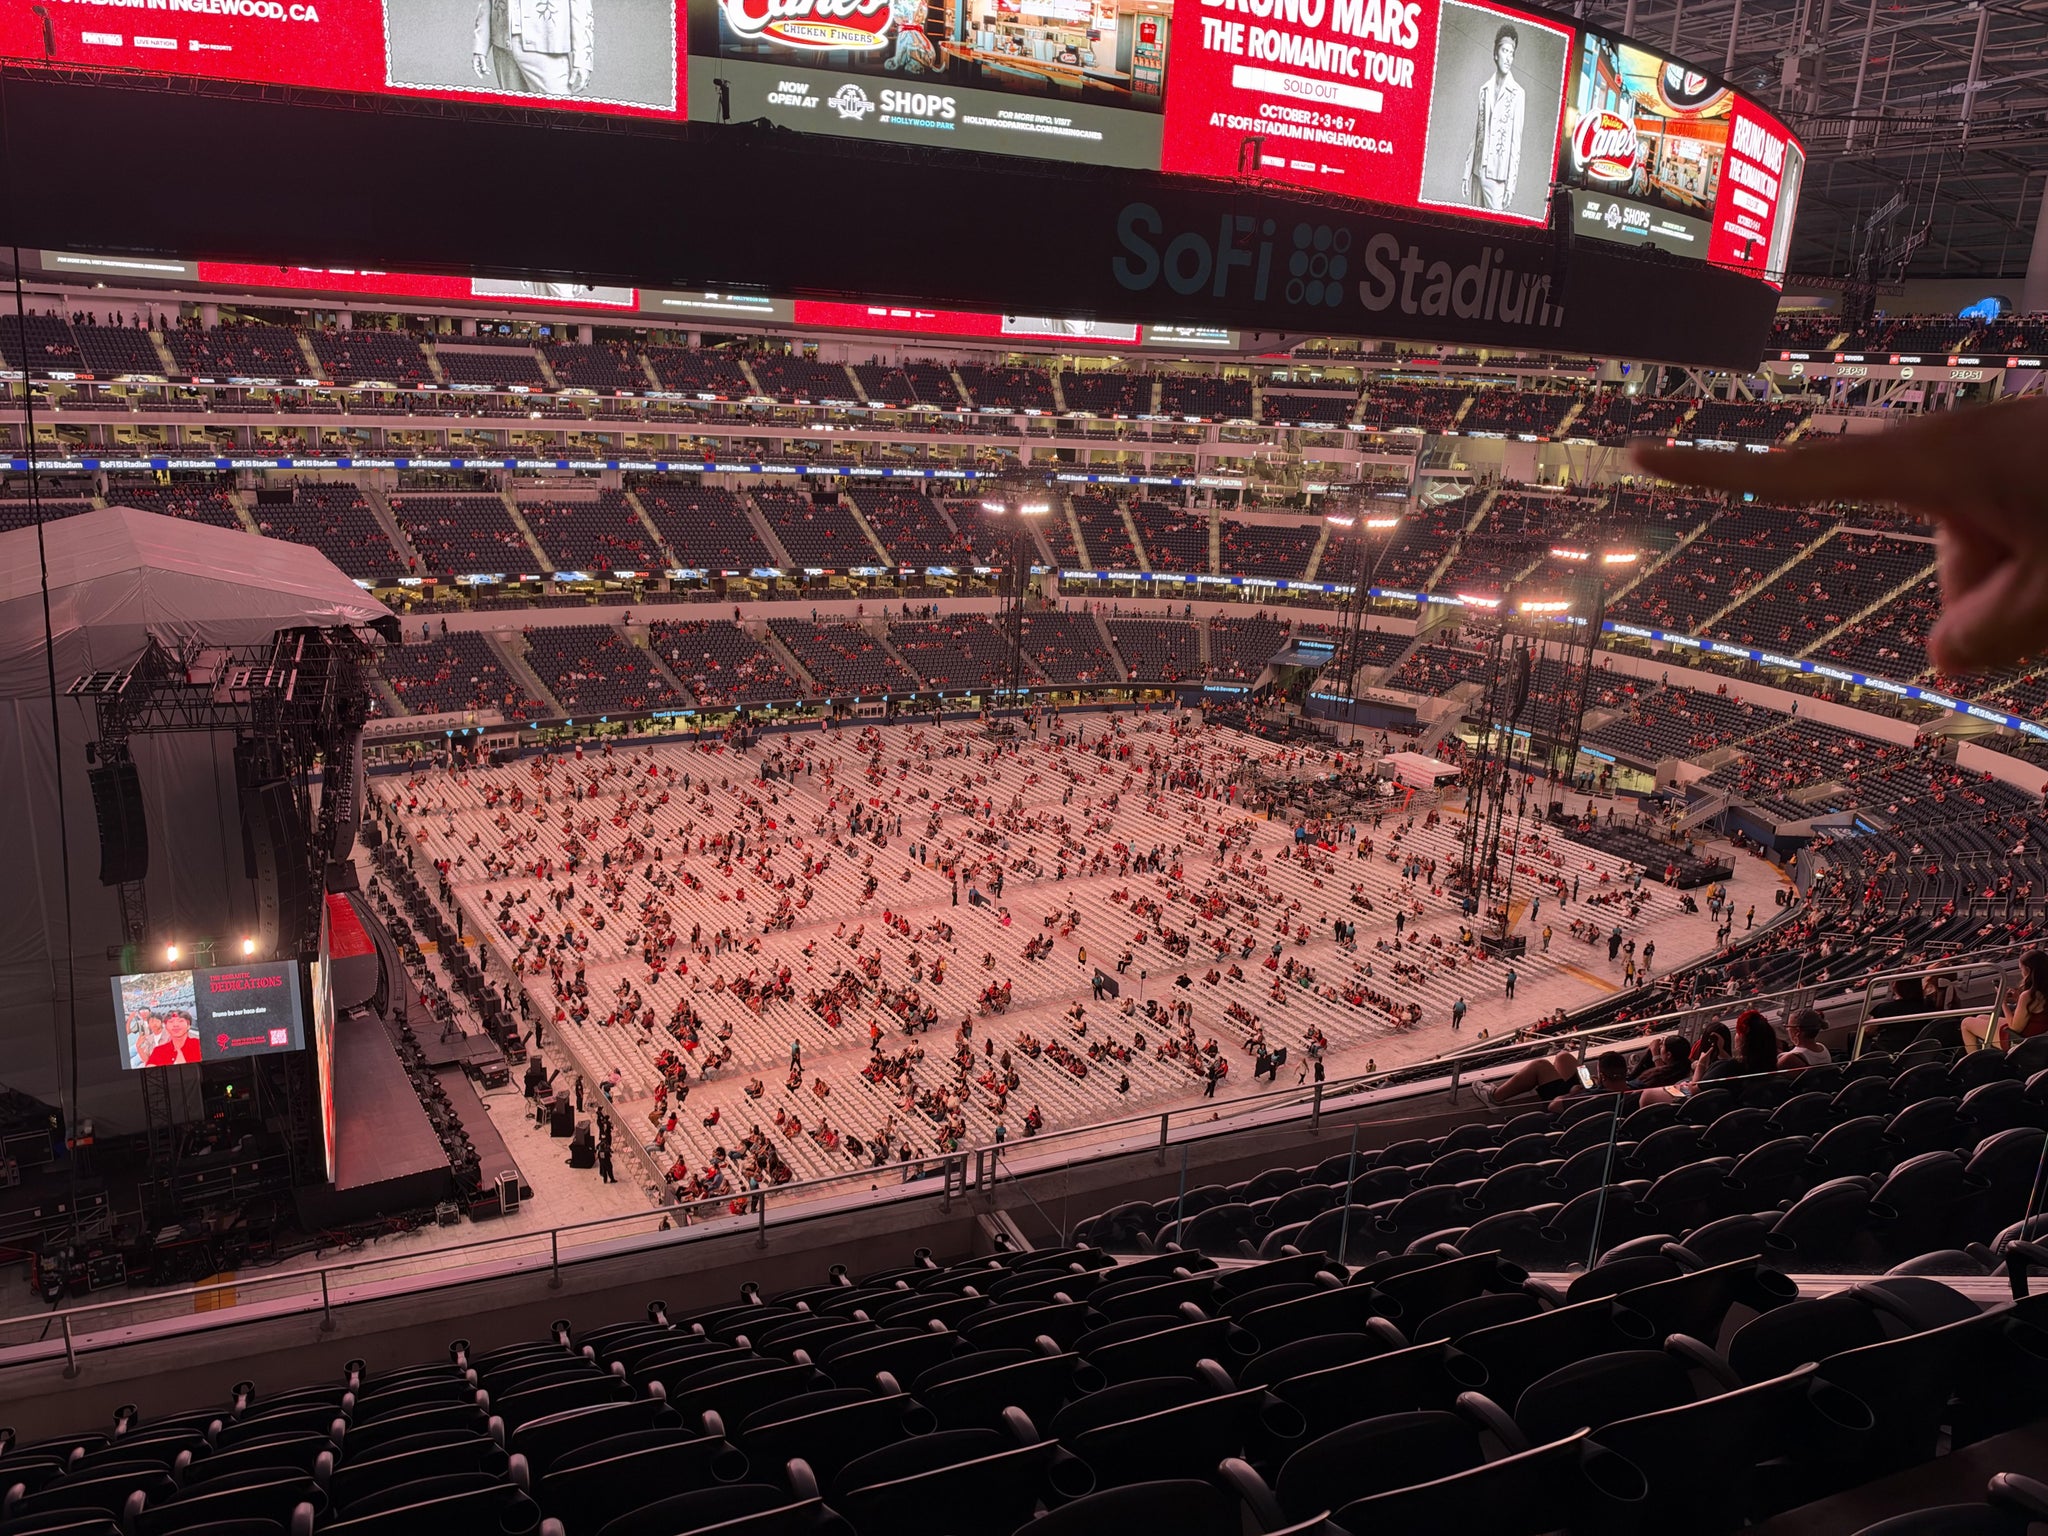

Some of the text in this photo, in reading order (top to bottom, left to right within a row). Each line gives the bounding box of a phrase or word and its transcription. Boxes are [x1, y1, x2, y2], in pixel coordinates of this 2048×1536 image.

[169, 0, 288, 22] INGLEWOOD,
[289, 4, 319, 22] CA
[1331, 0, 1422, 49] MARS
[783, 23, 873, 43] CHICKEN FINGERS
[1201, 16, 1415, 89] THE ROMANTIC TOUR
[778, 81, 809, 95] NOW
[1284, 78, 1339, 99] SOLD OUT
[768, 92, 820, 108] OPEN AT
[880, 89, 956, 119] SHOPS
[998, 110, 1014, 119] FOR
[1014, 112, 1034, 122] MORE
[1055, 116, 1072, 127] VISIT
[1260, 103, 1311, 124] OCTOBER
[880, 114, 956, 130] AT HOLLYWOOD PARK
[1602, 115, 1624, 131] Raising
[1210, 112, 1393, 154] AT SOFI STADIUM IN INGLEWOOD, CA
[1732, 114, 1785, 175] BRUNO MARS
[1623, 207, 1651, 228] SHOPS
[1112, 202, 1565, 328] SoFi Stadium
[1844, 354, 1864, 362] TOYOTA
[1837, 366, 1868, 376] PEPSI
[1950, 369, 1983, 380] PEPSI
[53, 461, 83, 469] Stadium
[1314, 642, 1334, 650] Beverage
[1679, 637, 1700, 646] Stadium
[1728, 647, 1750, 657] Stadium
[1762, 654, 1800, 668] SoFi Stadium
[1813, 666, 1852, 680] SoFi Stadium
[1865, 678, 1906, 693] SoFi Stadium
[1920, 692, 1956, 707] SoFi Stadium
[671, 709, 695, 717] Beverage
[1967, 706, 2007, 723] SoFi Stadium
[210, 975, 283, 993] DEDICATIONS
